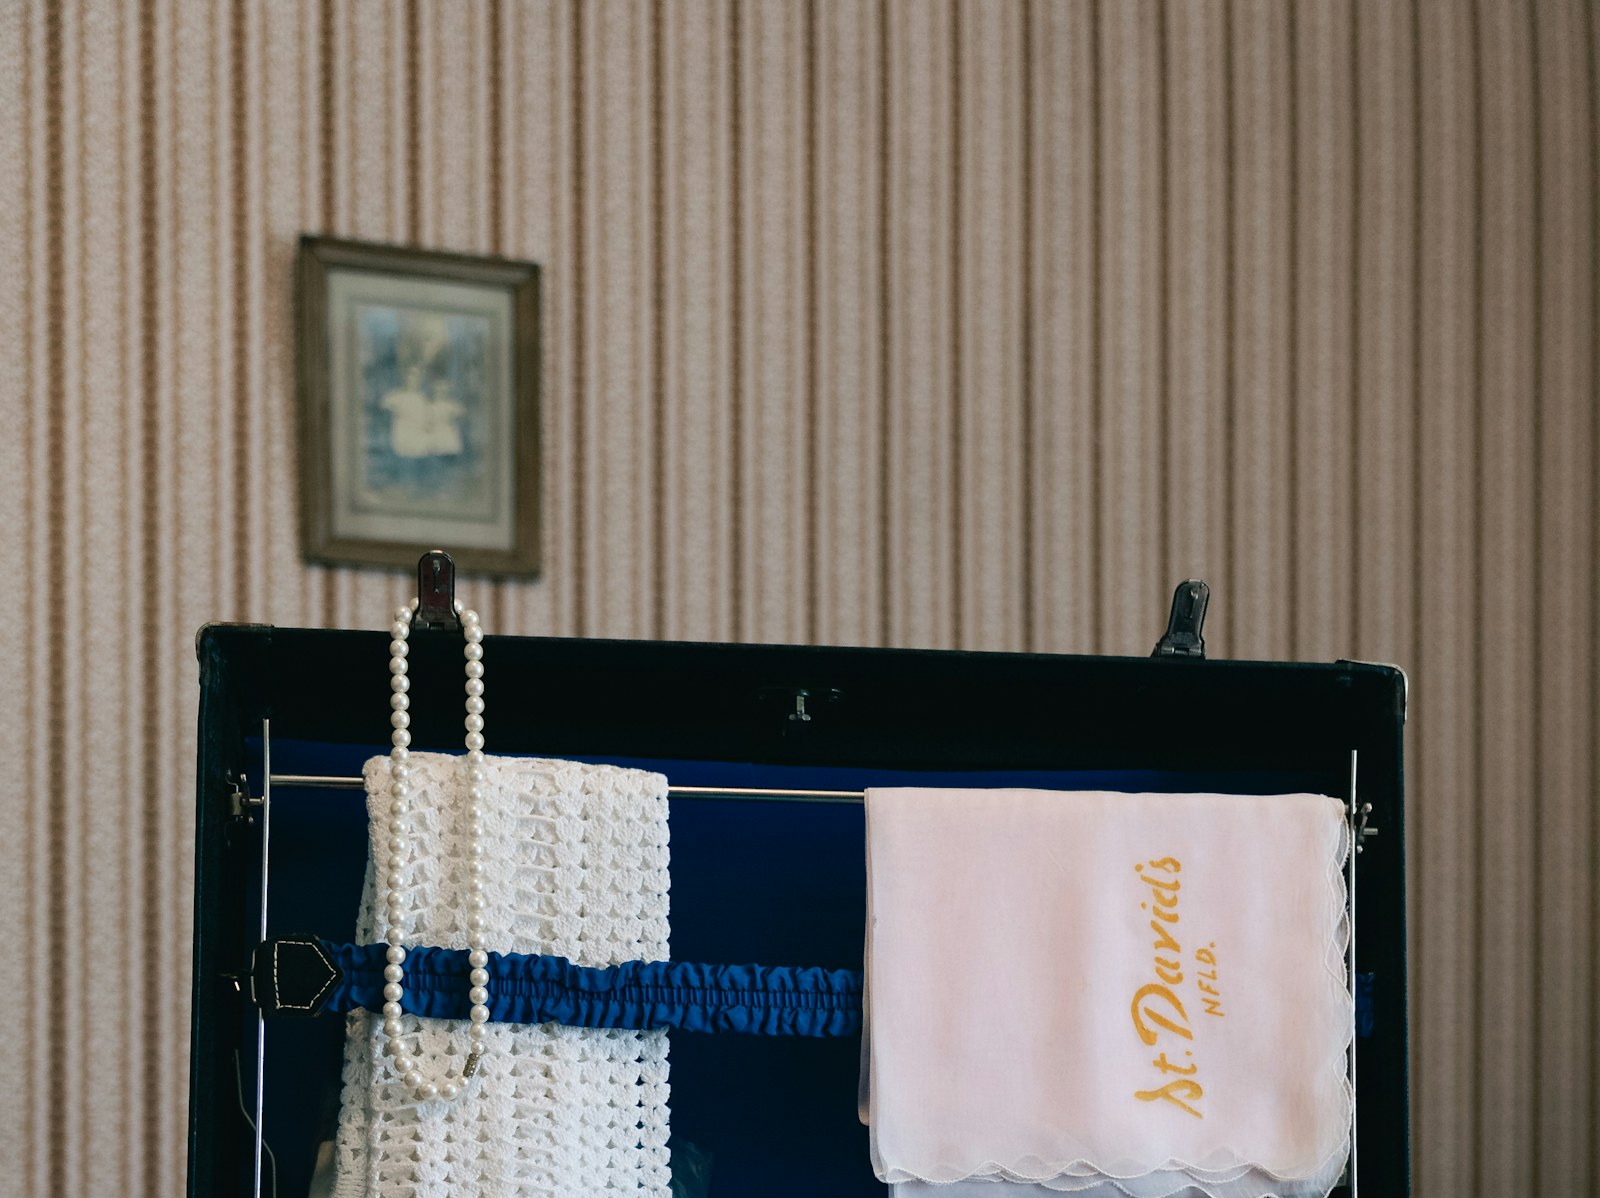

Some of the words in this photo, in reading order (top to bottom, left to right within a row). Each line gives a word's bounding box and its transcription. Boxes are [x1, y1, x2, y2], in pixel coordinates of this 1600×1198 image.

[1131, 856, 1194, 1046] David's
[1195, 942, 1225, 1017] NFLD.
[1134, 1050, 1203, 1120] St.
